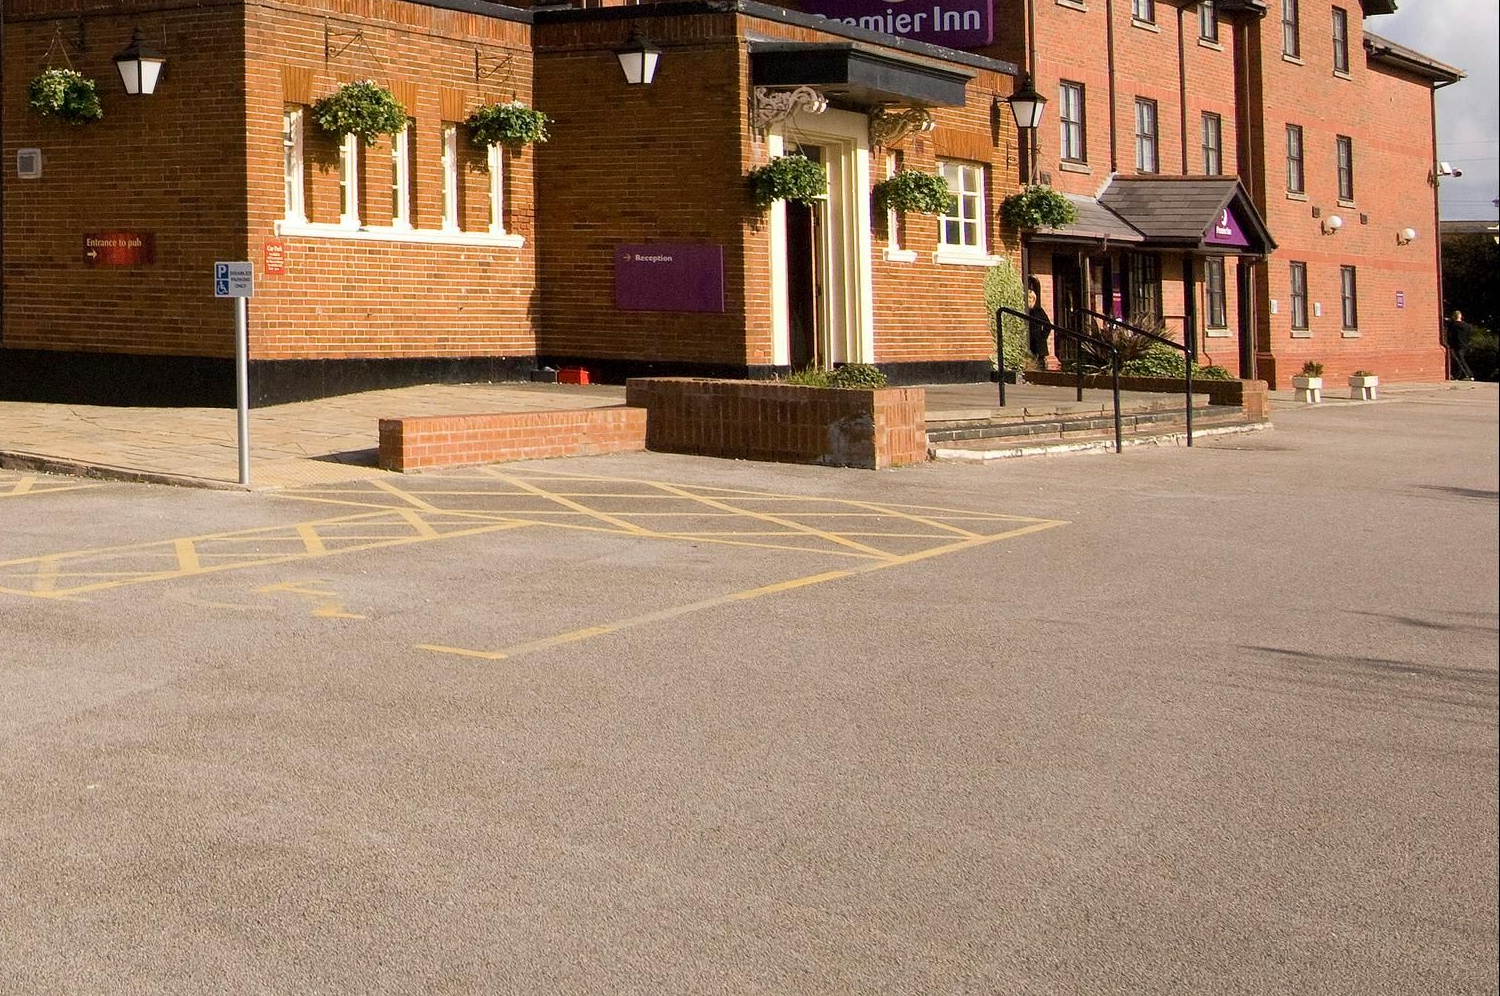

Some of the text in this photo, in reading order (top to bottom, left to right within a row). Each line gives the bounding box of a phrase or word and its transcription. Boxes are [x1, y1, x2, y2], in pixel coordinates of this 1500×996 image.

[813, 6, 981, 33] mier Inn
[86, 238, 142, 250] Entrance to pub
[635, 254, 673, 262] Reception
[218, 265, 227, 278] P
